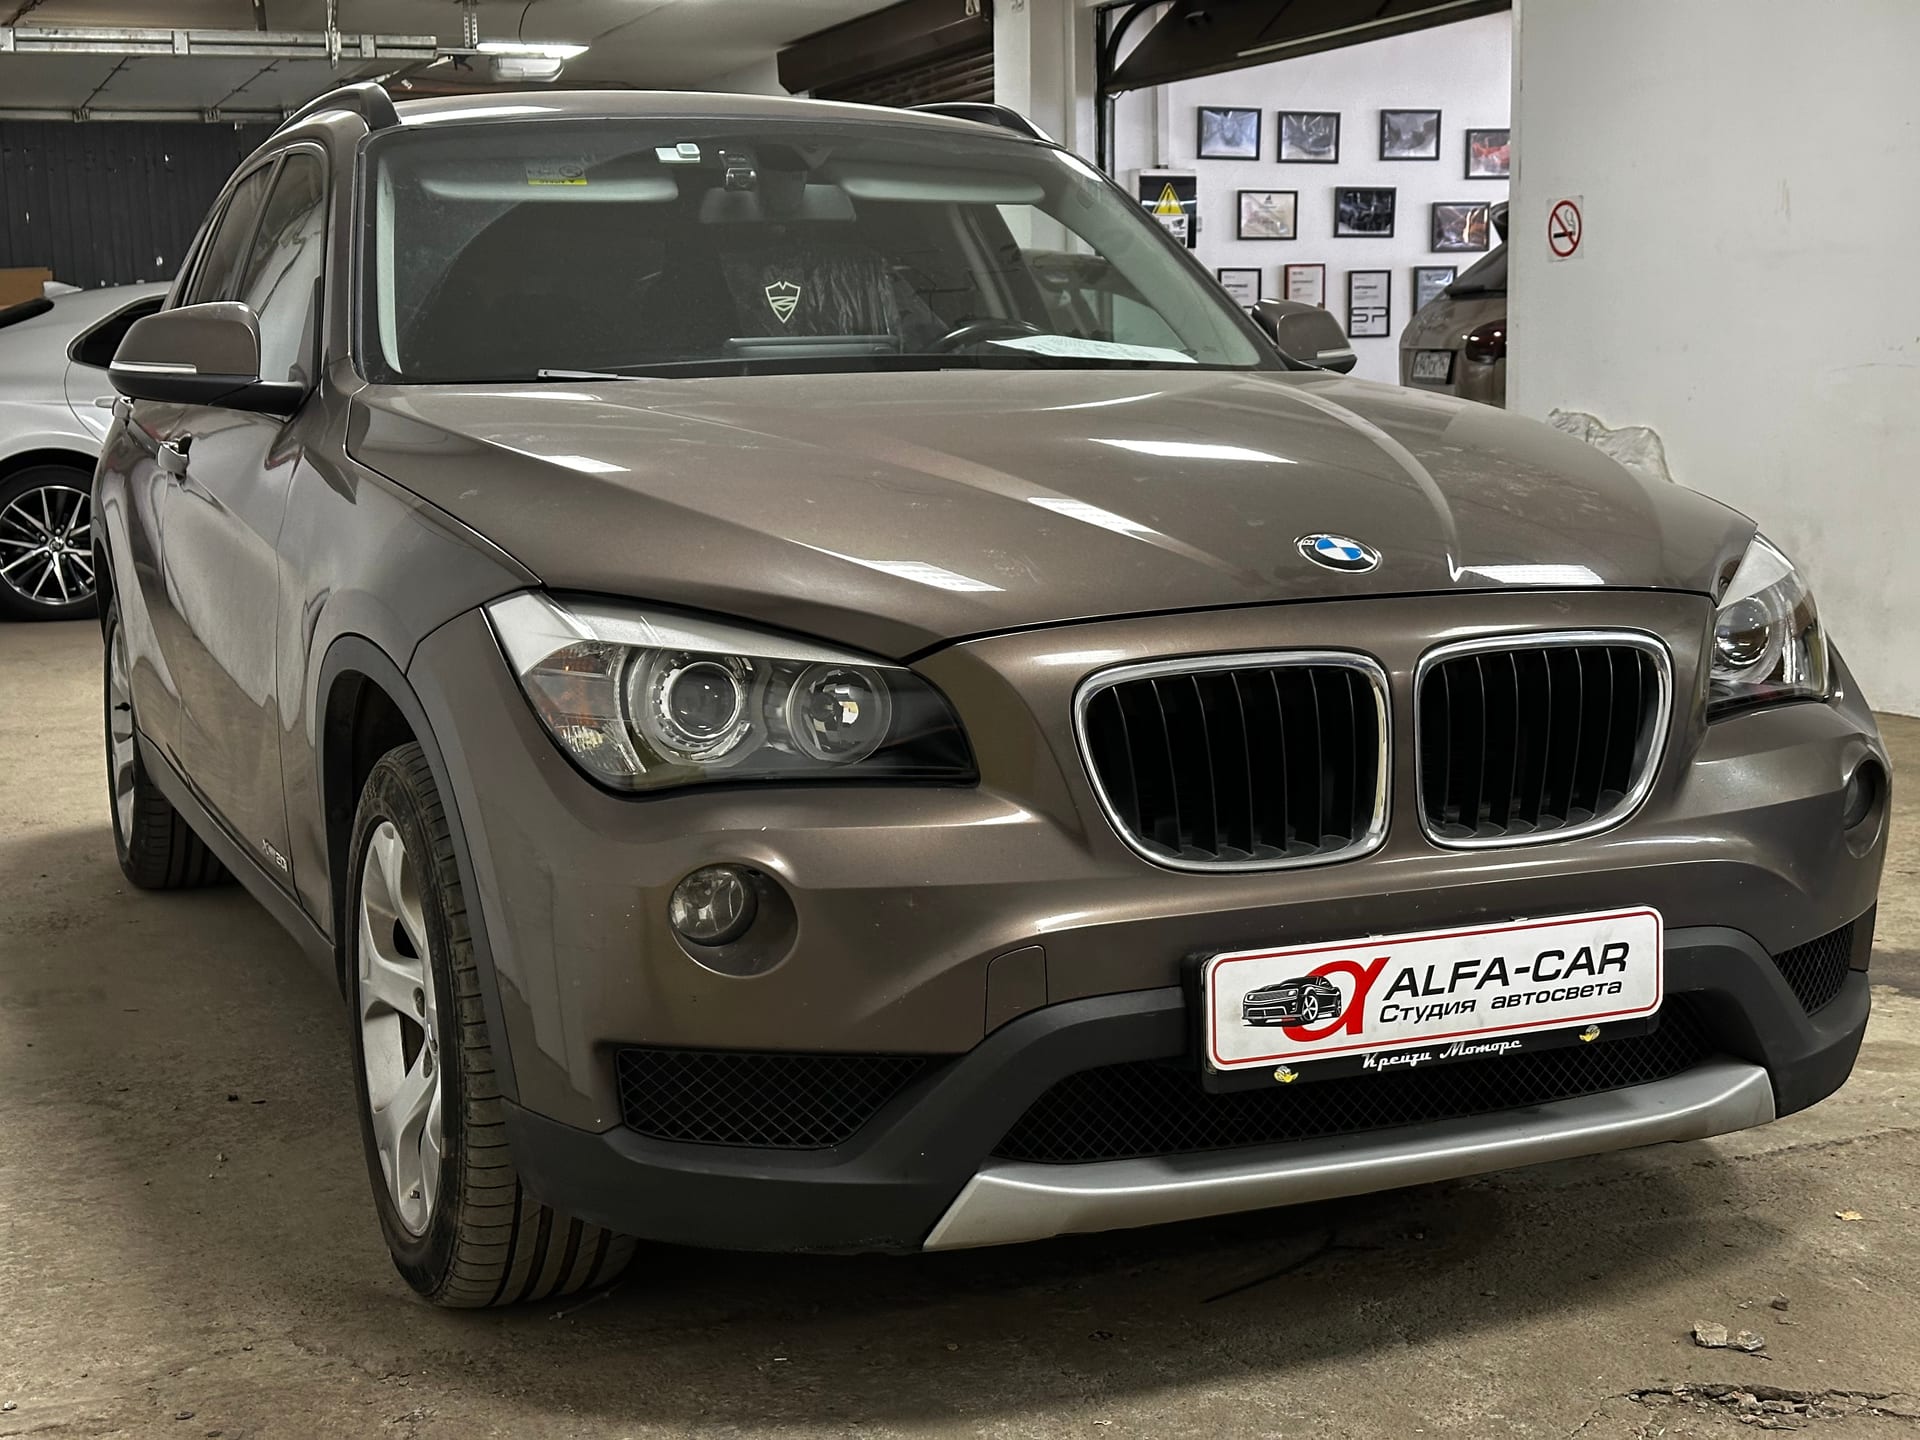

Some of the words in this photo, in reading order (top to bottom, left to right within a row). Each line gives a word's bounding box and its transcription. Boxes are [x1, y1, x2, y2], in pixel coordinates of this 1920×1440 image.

[1382, 942, 1630, 1001] ALFA-CAR
[1379, 999, 1476, 1024] Студия
[1491, 980, 1622, 1010] автосвета
[1362, 1052, 1432, 1072] Крейзи
[1439, 1040, 1522, 1059] Моторс
